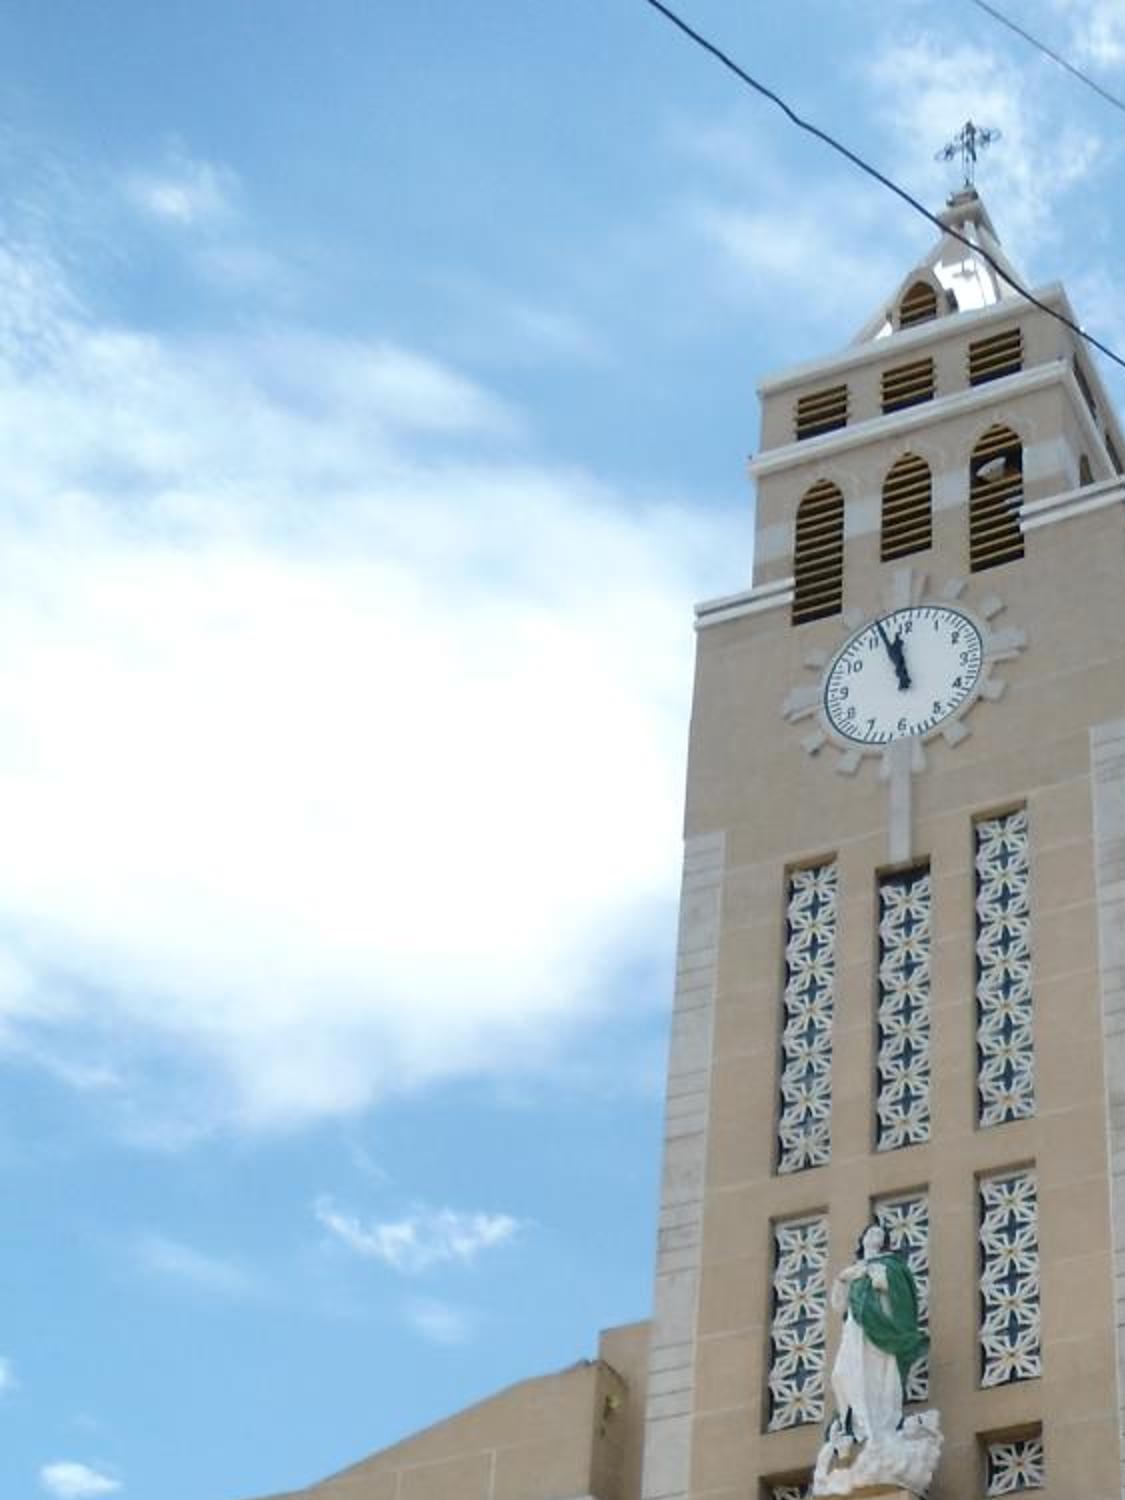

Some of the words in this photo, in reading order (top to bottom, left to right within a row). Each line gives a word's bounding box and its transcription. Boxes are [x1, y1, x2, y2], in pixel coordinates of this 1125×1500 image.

[897, 621, 912, 634] 12
[869, 636, 879, 650] 11
[951, 631, 960, 645] 2
[960, 652, 969, 667] 3
[845, 660, 863, 674] 10
[952, 677, 962, 688] 4
[839, 687, 849, 700] 9
[846, 707, 856, 719] 8
[933, 701, 941, 714] 5
[867, 719, 876, 732] 7
[897, 718, 907, 731] 6
